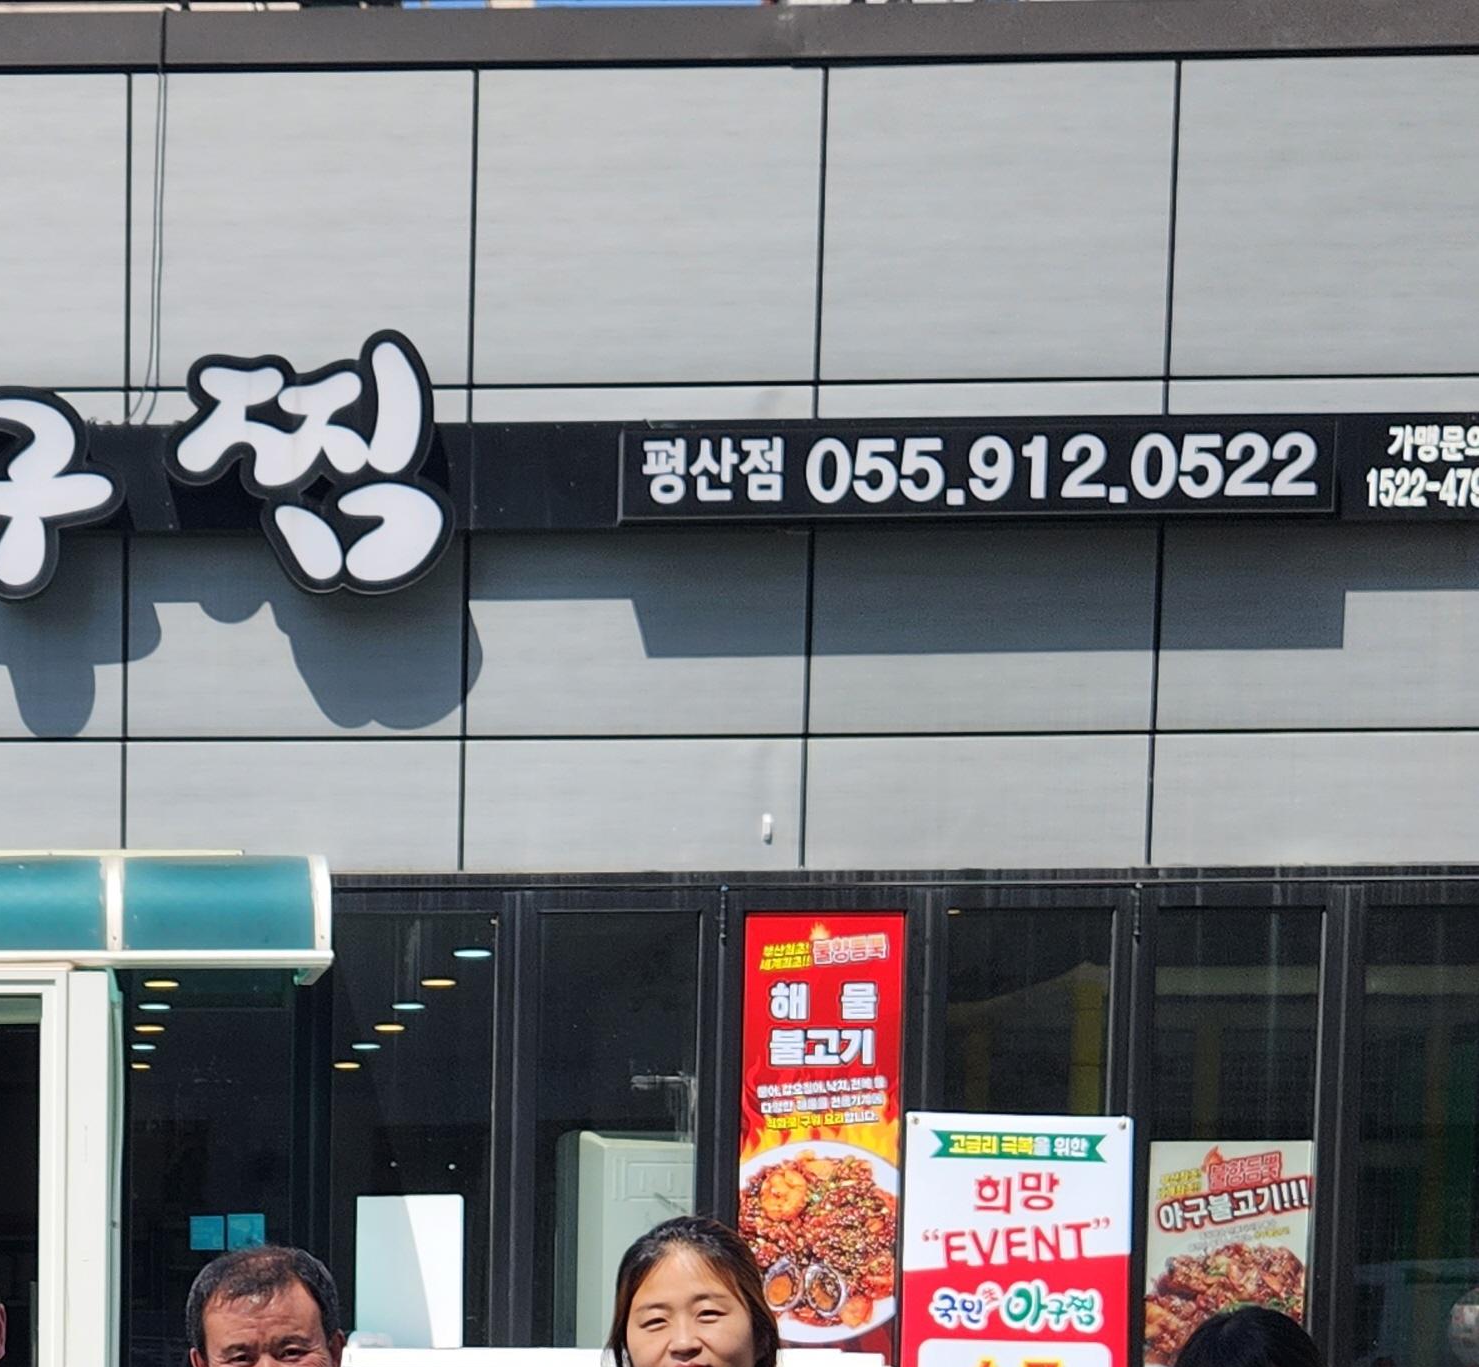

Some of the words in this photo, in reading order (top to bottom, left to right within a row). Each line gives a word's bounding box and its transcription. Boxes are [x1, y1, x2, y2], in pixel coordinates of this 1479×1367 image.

[642, 436, 785, 504] 평산점
[805, 432, 1318, 506] 055.912.0522
[770, 1028, 875, 1066] 불고기
[949, 1134, 997, 1155] 고금리
[1001, 1135, 1050, 1156] 극복을
[1053, 1137, 1089, 1157] 위한
[974, 1172, 1060, 1214] 희망
[1159, 1179, 1310, 1230] 아구불고기!!!
[934, 1293, 984, 1325] 국민
